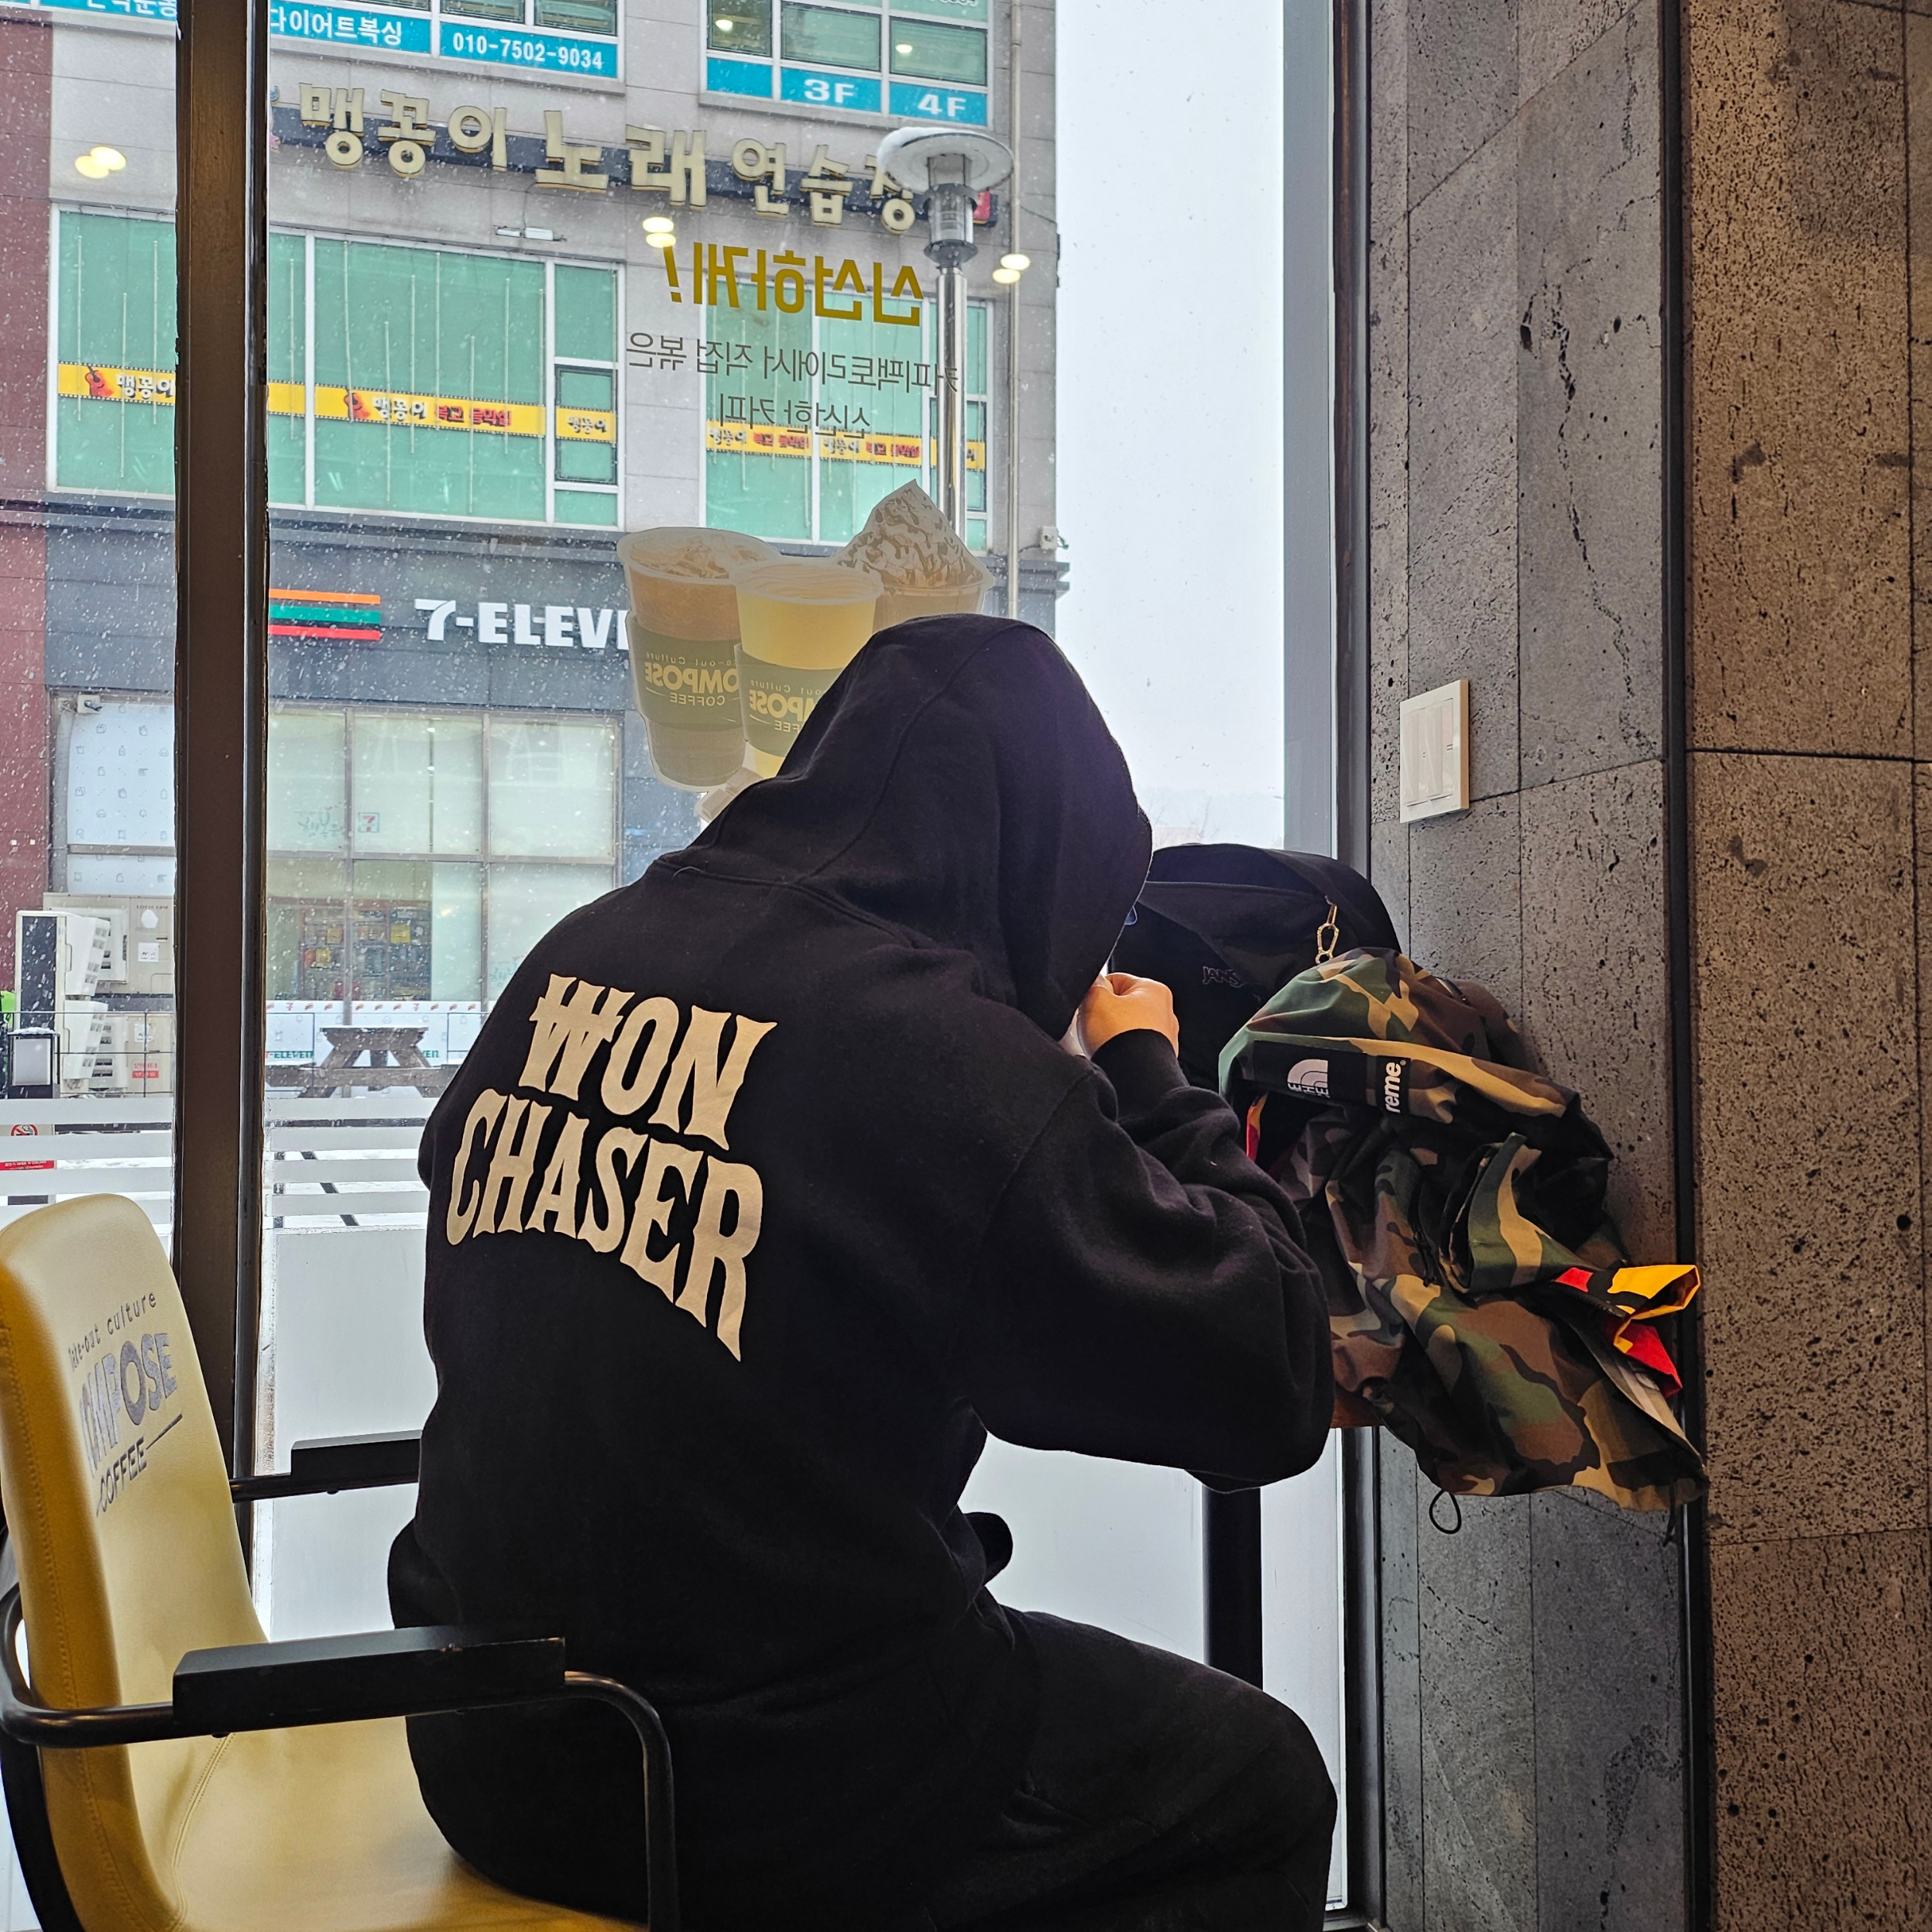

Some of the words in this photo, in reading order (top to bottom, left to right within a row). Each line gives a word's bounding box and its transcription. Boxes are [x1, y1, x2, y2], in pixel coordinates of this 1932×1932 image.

[270, 6, 401, 46] 다이어트복싱
[452, 33, 603, 70] 010-7502-9034
[804, 79, 855, 104] 3F
[917, 94, 967, 117] 4F
[447, 1088, 764, 1362] CHASER
[107, 1292, 156, 1335] culture
